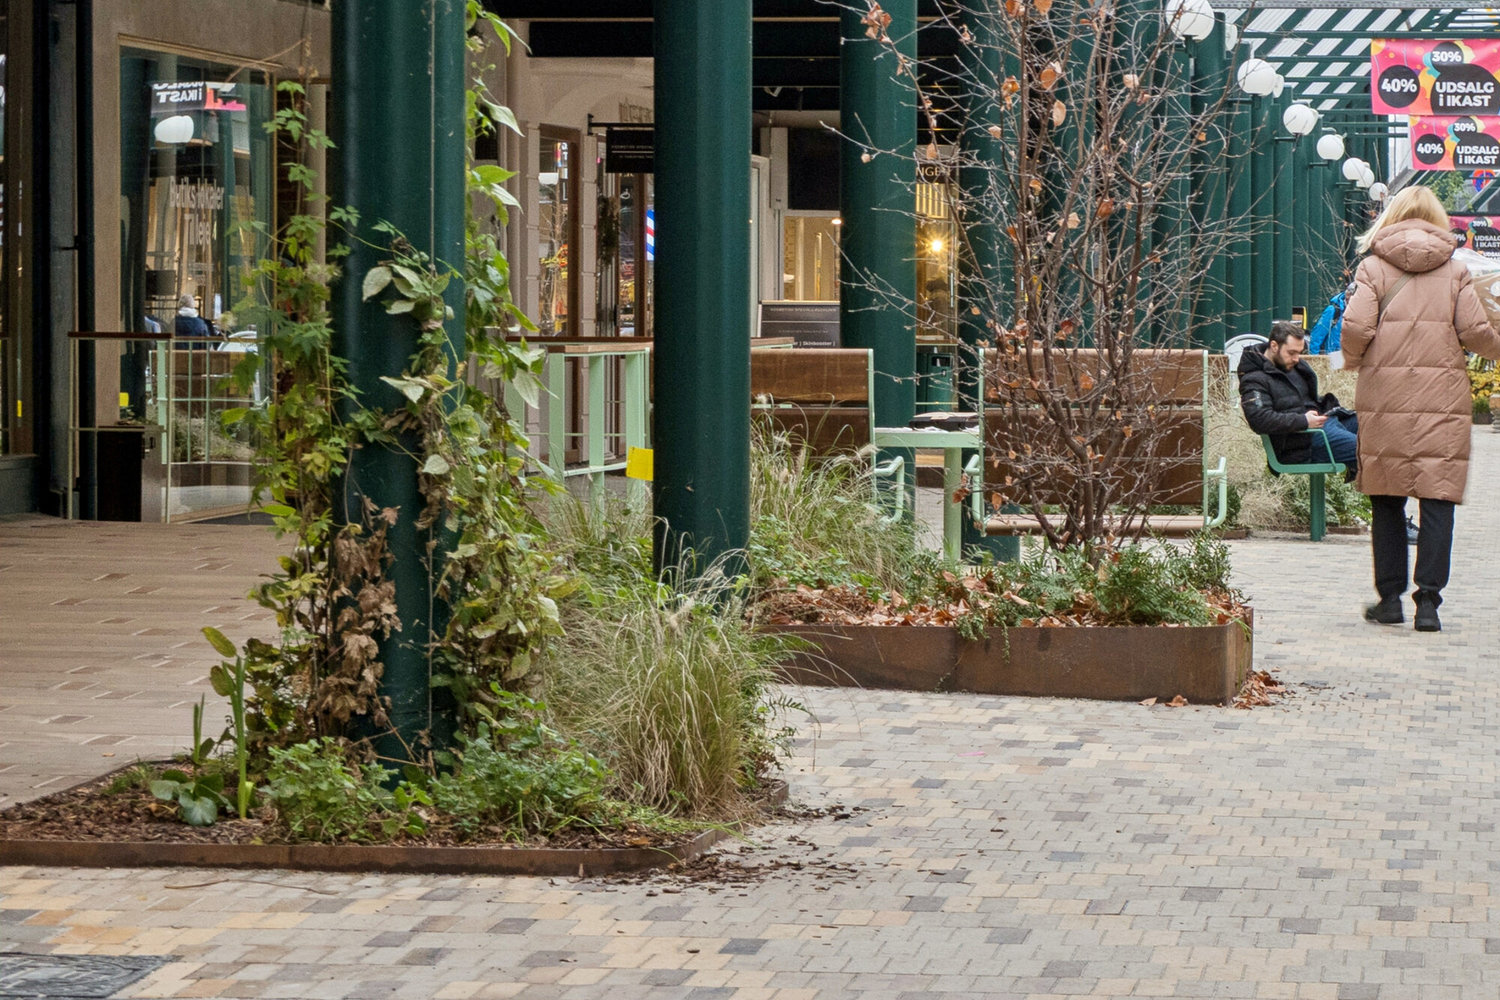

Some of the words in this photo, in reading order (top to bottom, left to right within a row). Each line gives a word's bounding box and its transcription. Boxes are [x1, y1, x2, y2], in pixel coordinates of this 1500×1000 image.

[1432, 51, 1462, 62] 30%
[1381, 78, 1417, 92] 40%
[1435, 82, 1494, 93] UDSALG
[1439, 94, 1444, 106] i
[1446, 95, 1491, 106] IKAST
[1454, 123, 1476, 132] 30%
[1417, 143, 1444, 154] 40%
[1456, 146, 1500, 154] UDSALG
[1464, 156, 1498, 165] IKAST
